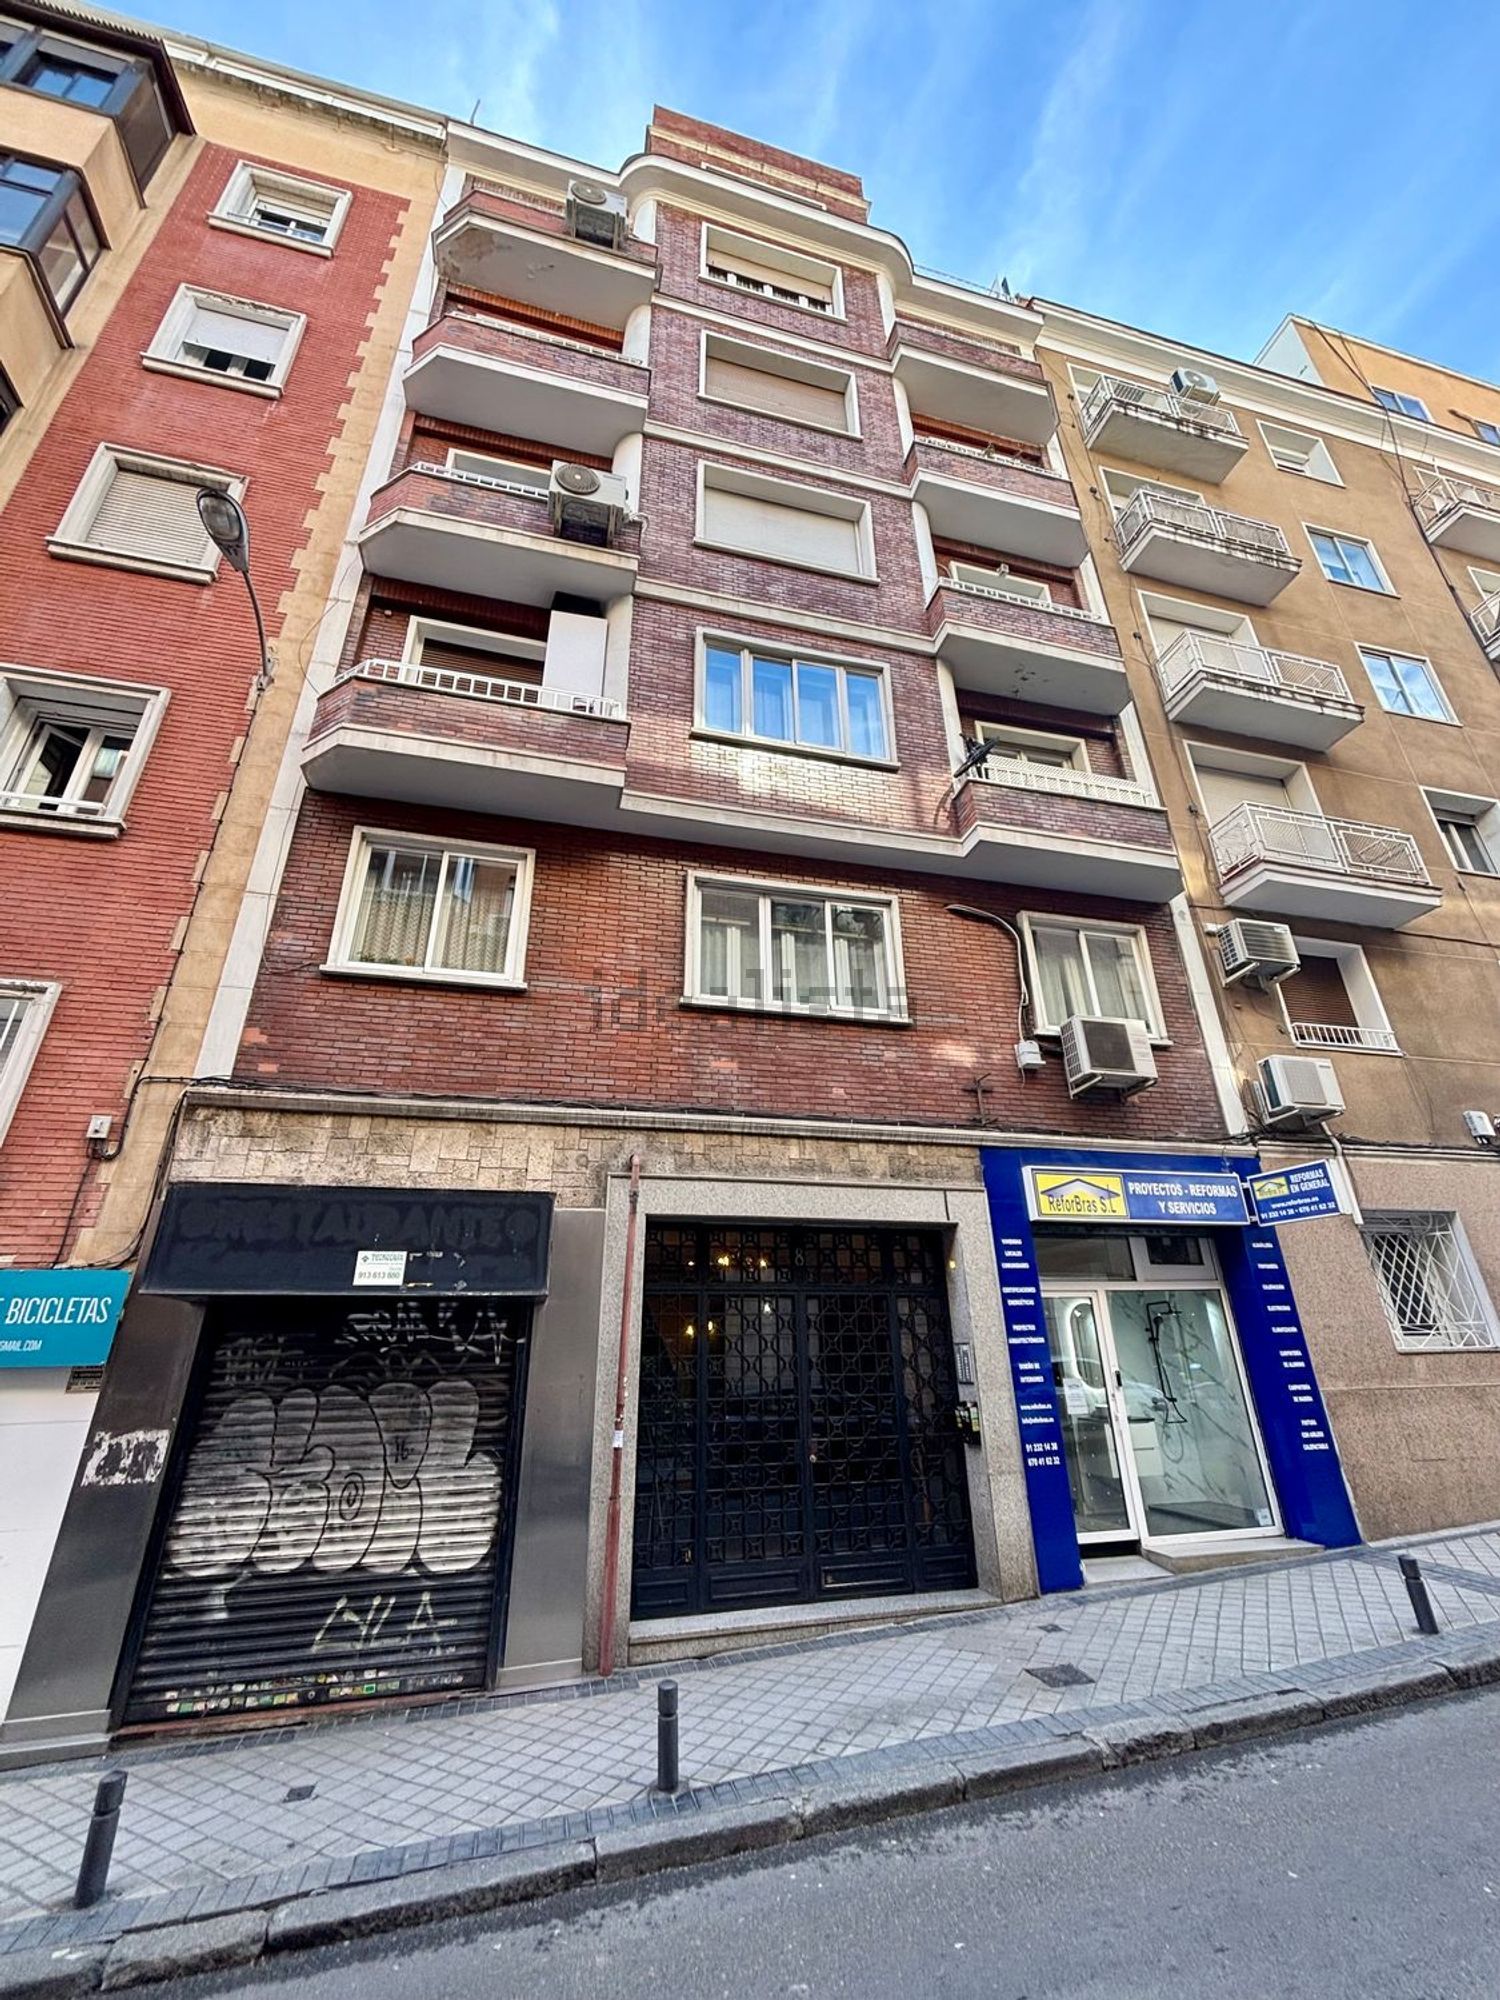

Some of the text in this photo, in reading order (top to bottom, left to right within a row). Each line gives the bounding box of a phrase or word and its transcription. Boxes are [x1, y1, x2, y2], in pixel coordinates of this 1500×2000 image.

[1289, 1168, 1324, 1184] REFORMAS
[1128, 1182, 1183, 1196] PROYECTOS
[1189, 1184, 1238, 1198] REFORMAS
[1290, 1183, 1300, 1193] EN
[1300, 1178, 1330, 1192] GENERAL
[1048, 1194, 1098, 1213] ReforBras
[1158, 1201, 1217, 1215] Y SERVICIOS
[5, 1297, 112, 1324] BICICLETAS
